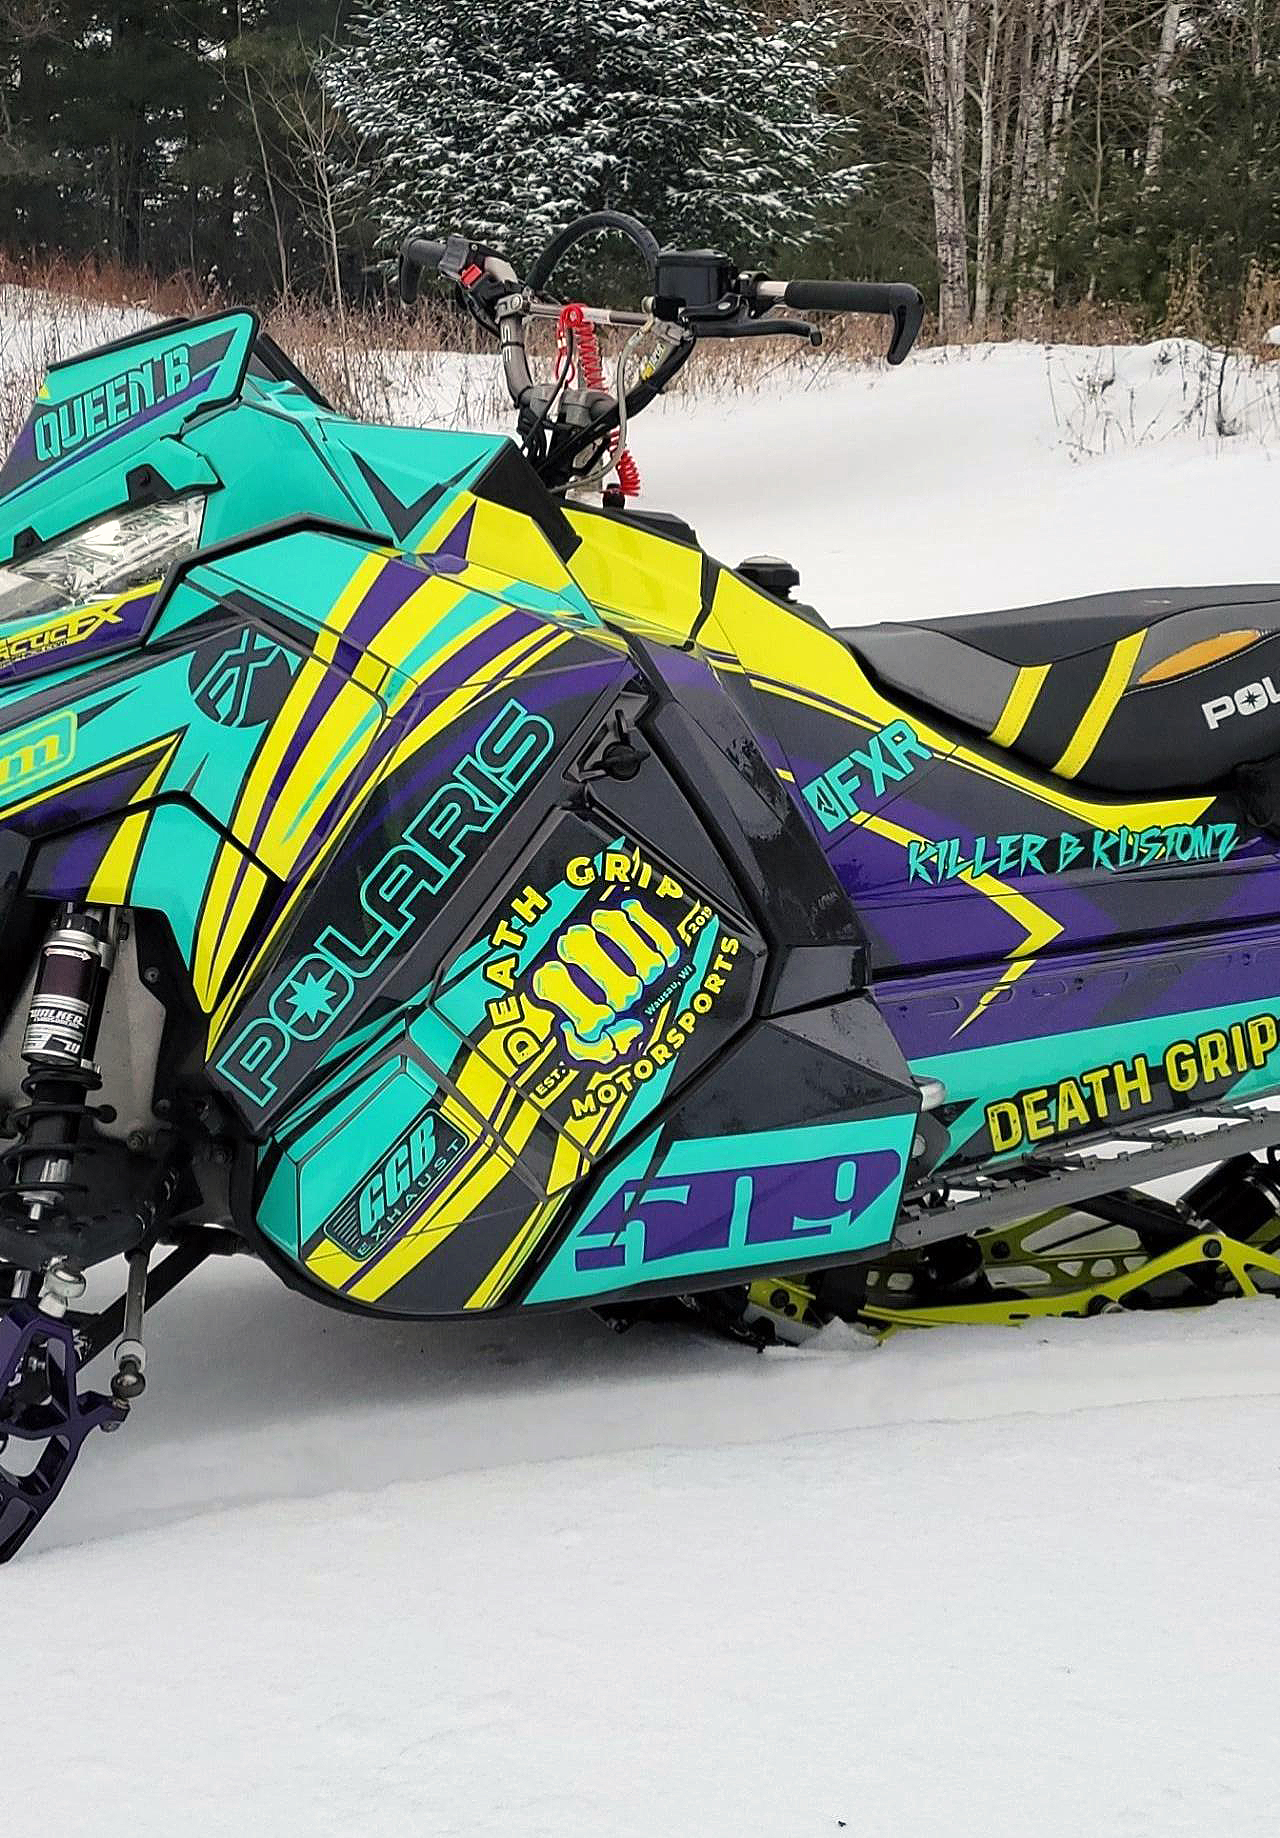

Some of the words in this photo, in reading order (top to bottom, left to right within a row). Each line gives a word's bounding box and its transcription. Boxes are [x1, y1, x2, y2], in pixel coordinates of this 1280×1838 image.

[34, 359, 155, 462] QUEEN
[163, 345, 192, 398] B
[823, 720, 933, 817] FXR
[217, 699, 554, 1108] POLARIS
[908, 833, 1049, 887] KILLER
[1056, 832, 1085, 874] B
[1091, 823, 1241, 872] KUSTOMZ
[486, 885, 548, 1066] DEATH
[566, 852, 684, 901] GRIP
[572, 936, 740, 1118] MOTORSPORTS
[987, 1056, 1153, 1156] DEATH
[1162, 1015, 1278, 1095] GRIP
[358, 1138, 460, 1256] EXHAUST
